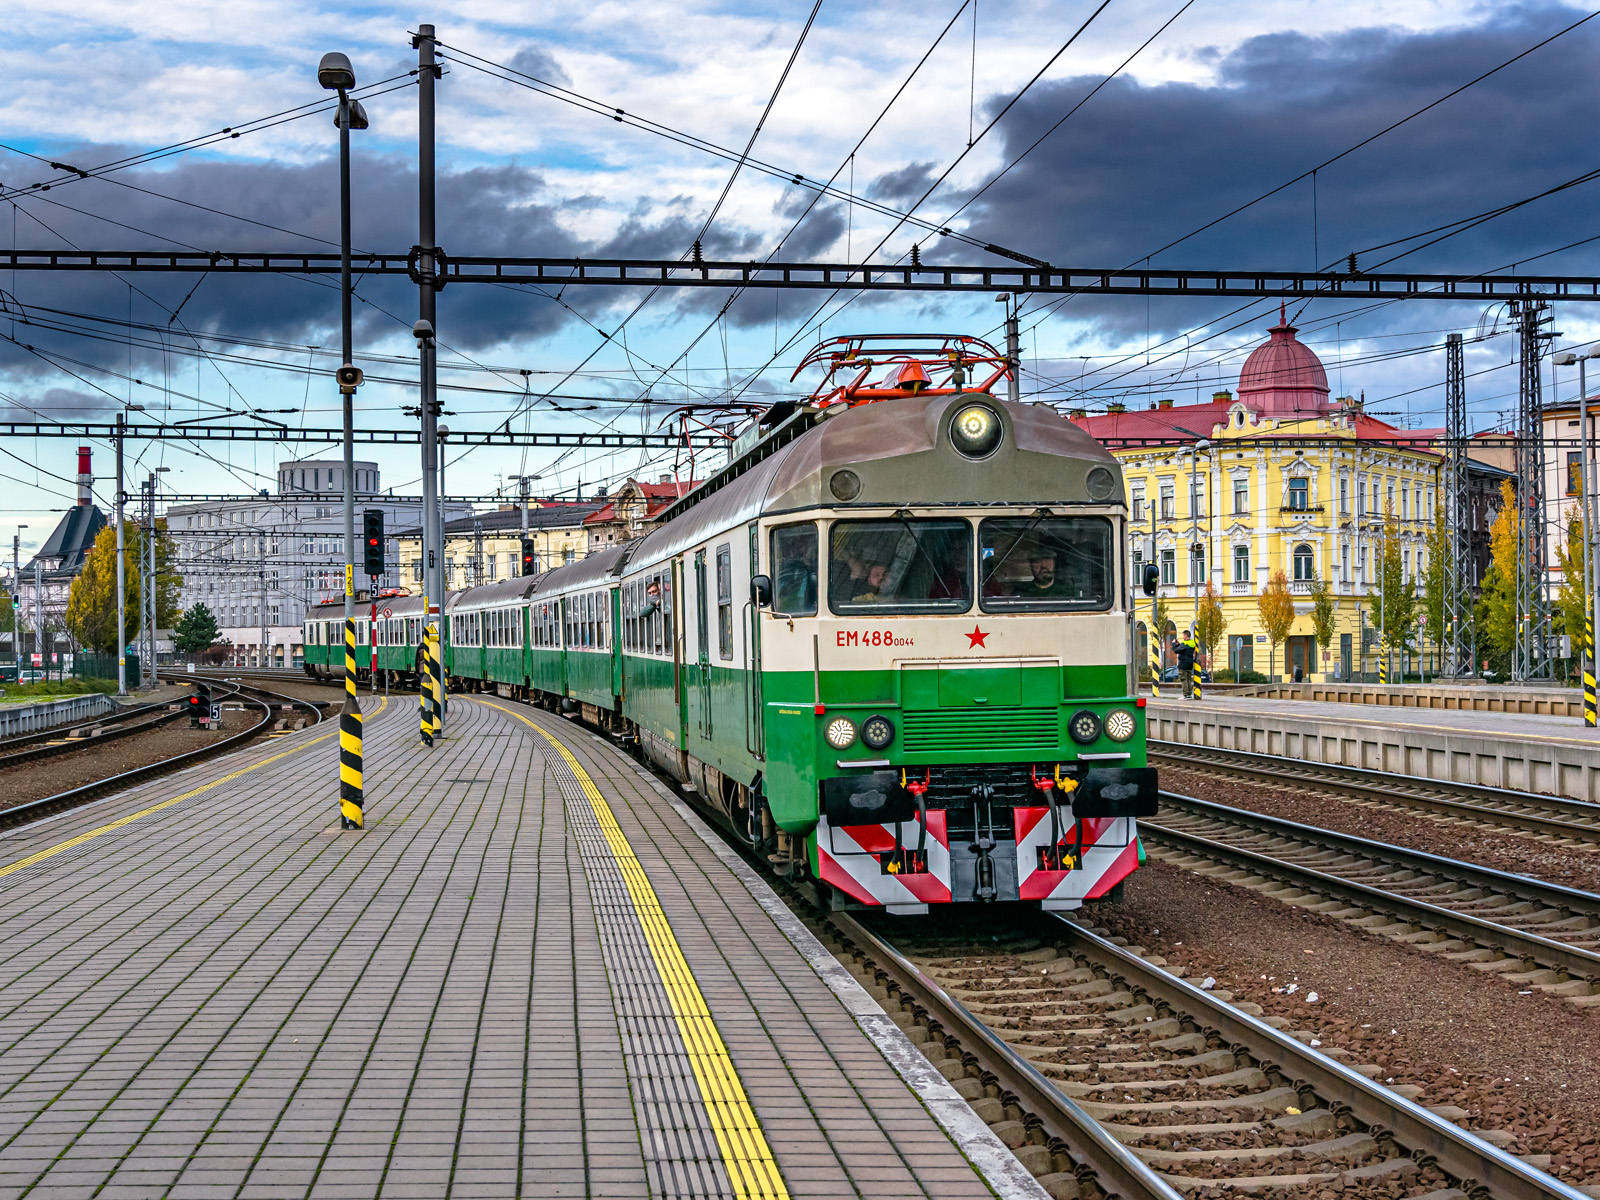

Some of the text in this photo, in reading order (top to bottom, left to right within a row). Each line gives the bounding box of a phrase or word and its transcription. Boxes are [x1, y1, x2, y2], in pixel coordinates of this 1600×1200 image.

[371, 584, 378, 597] 5
[836, 630, 858, 647] EM
[212, 705, 219, 719] 5
